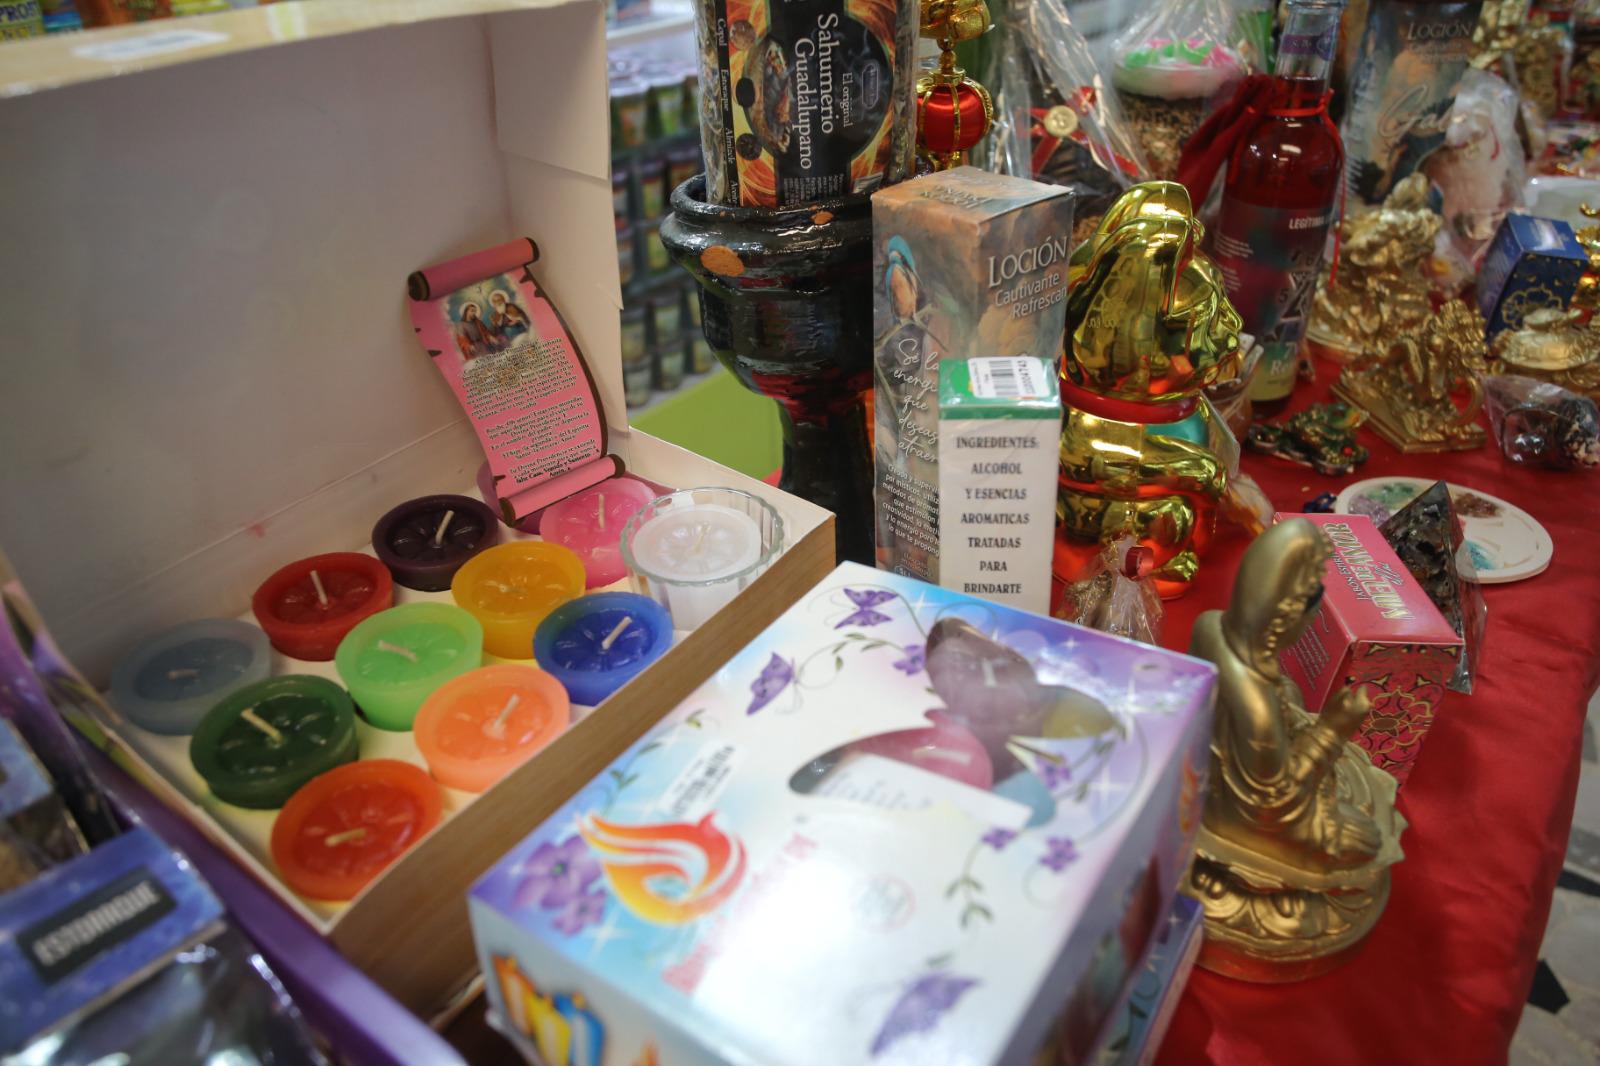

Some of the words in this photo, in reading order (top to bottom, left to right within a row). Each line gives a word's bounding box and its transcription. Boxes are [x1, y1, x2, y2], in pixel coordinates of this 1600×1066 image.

[716, 18, 727, 46] Copal
[1407, 19, 1473, 40] LOCIÓN
[818, 13, 840, 134] Sahumerio
[842, 72, 853, 85] El
[792, 38, 818, 170] Guadalupano
[840, 86, 853, 128] original
[988, 236, 1068, 288] LOCIÓN
[995, 271, 1060, 307] Cautivante
[971, 463, 1022, 474] ALCOHOL
[965, 488, 973, 499] Y
[975, 488, 1027, 499] ESENCIAS
[961, 513, 1030, 525] AROMATICAS
[968, 537, 1021, 548] TRATADAS
[980, 561, 1007, 571] PARA
[964, 583, 1022, 594] BRINDARTE
